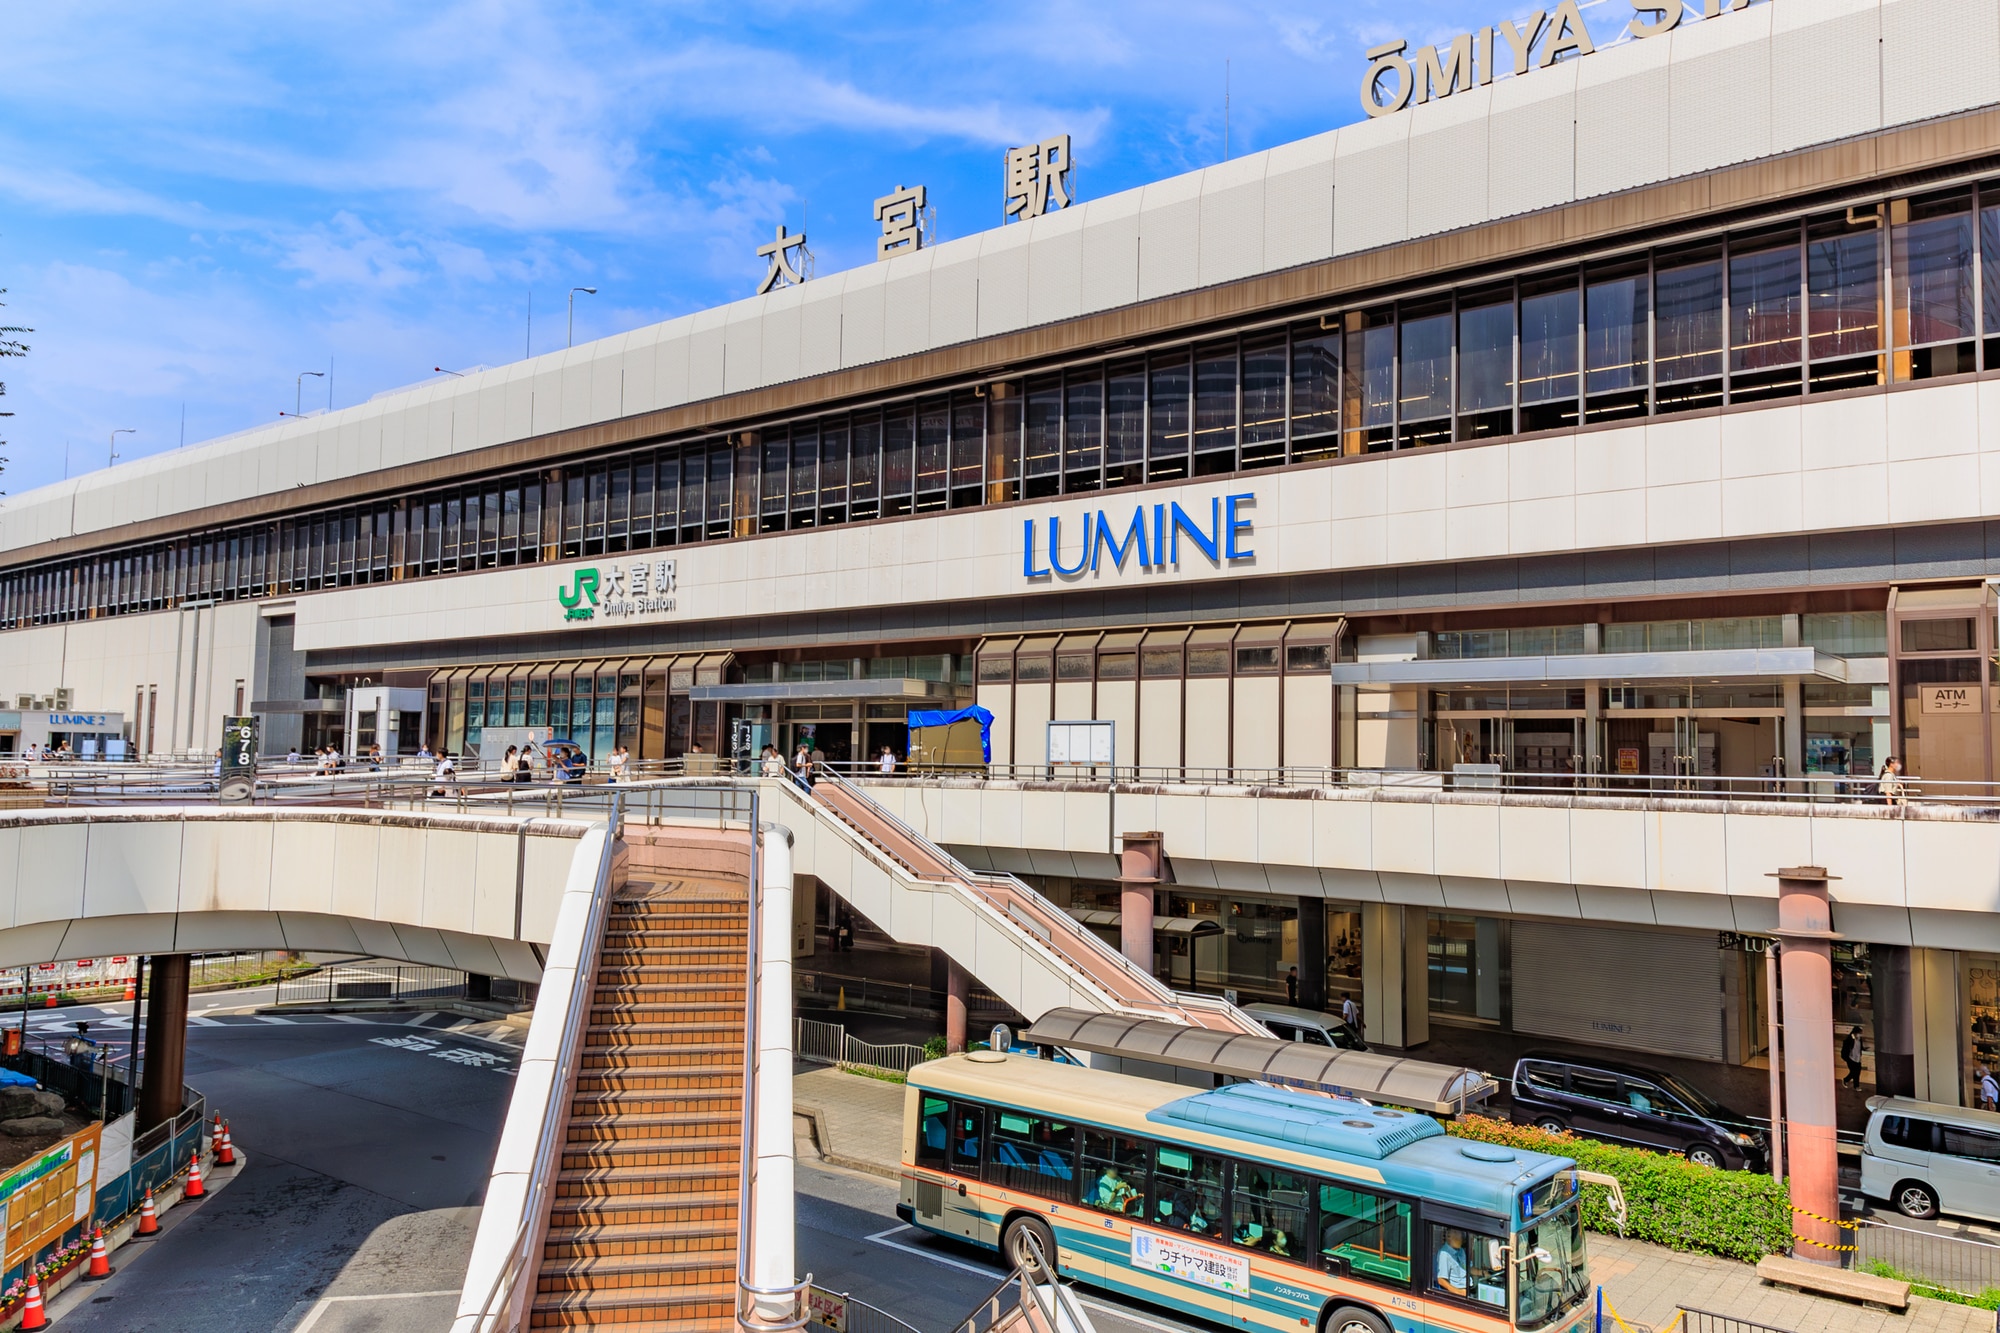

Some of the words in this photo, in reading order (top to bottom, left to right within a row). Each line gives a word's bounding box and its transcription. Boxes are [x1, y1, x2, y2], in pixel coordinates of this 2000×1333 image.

[756, 134, 1071, 295] 大宮駅
[1024, 492, 1255, 577] LUMINE
[603, 560, 678, 598] 大宮駅
[559, 567, 600, 608] JR
[638, 596, 676, 613] Station
[1935, 689, 1967, 700] ATM
[1934, 701, 1970, 709] コーナー
[49, 714, 96, 725] LUMINE
[98, 715, 106, 726] 2
[240, 726, 252, 739] 6
[240, 739, 251, 751] 7
[238, 752, 250, 765] 8
[1273, 1285, 1311, 1301] ノンステップバス
[1391, 1296, 1417, 1311] A7-45
